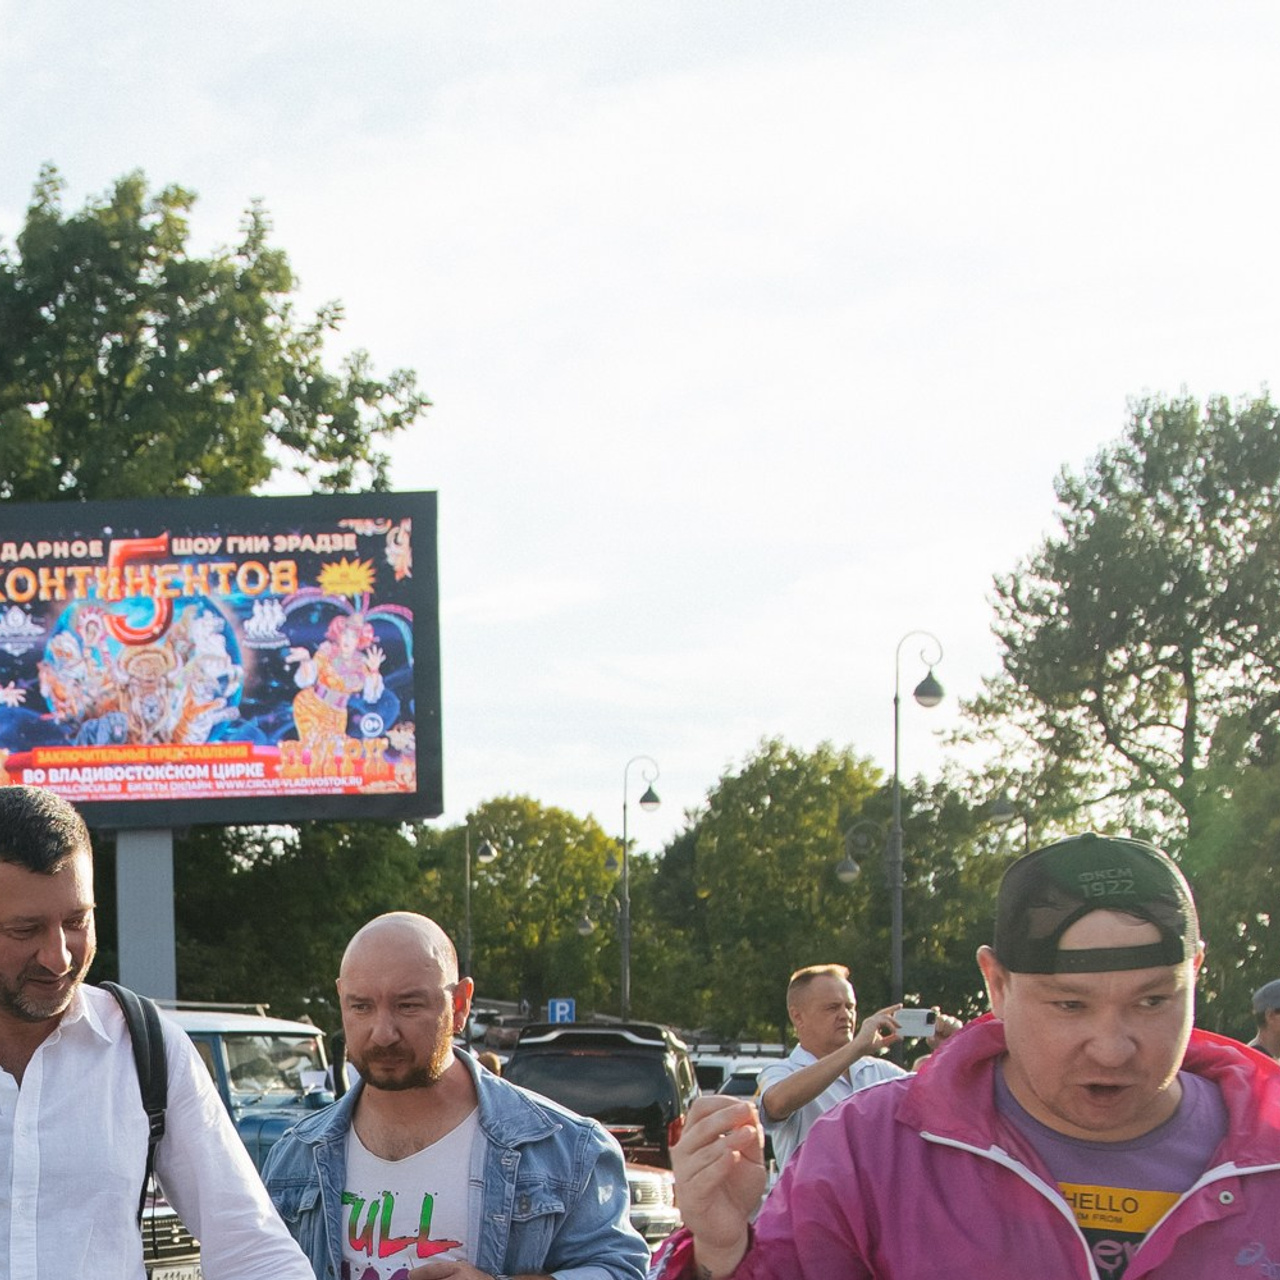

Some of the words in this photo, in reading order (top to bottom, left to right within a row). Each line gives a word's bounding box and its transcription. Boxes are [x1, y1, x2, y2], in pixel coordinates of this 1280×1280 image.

[171, 536, 221, 556] ШОУ
[226, 535, 270, 554] ГИИ
[273, 532, 357, 553] ЭРАДЗЕ
[23, 769, 46, 785] ВО
[48, 764, 209, 784] ВЛАДИВОСТОКСКОМ
[212, 762, 265, 781] ЦИРКЕ
[1081, 879, 1136, 899] 1922
